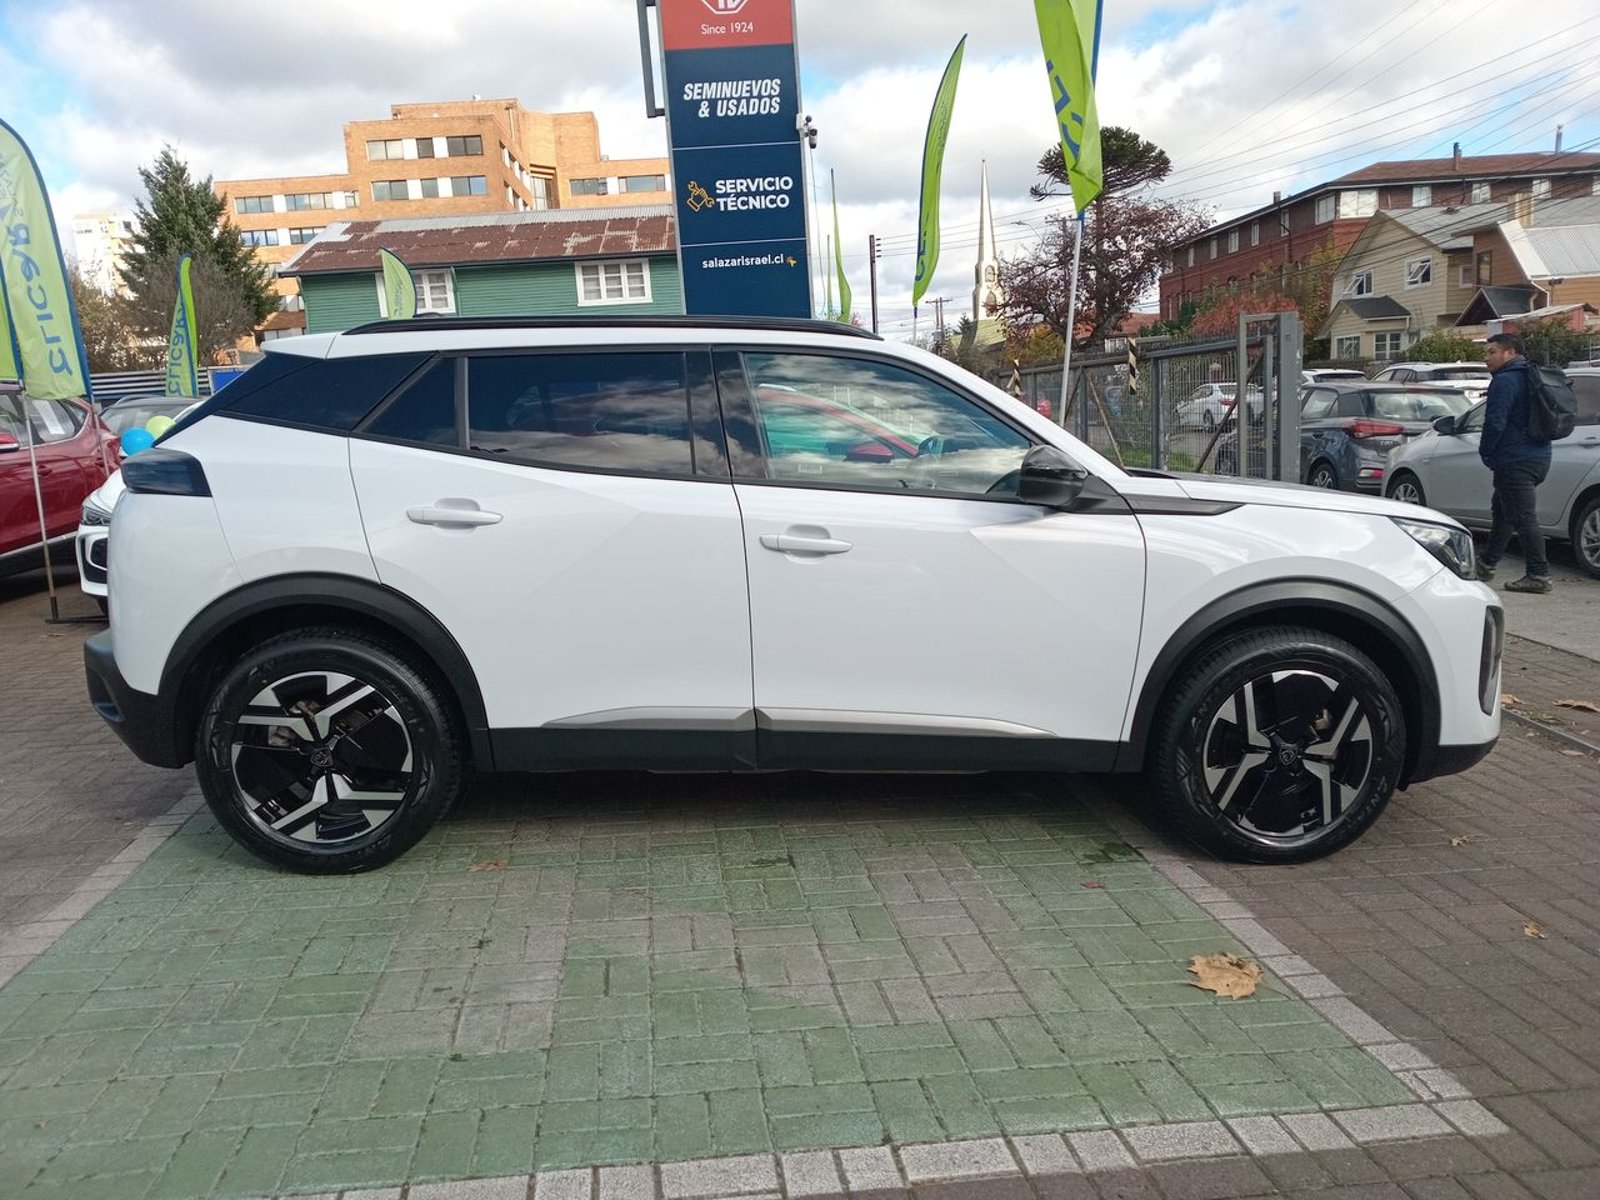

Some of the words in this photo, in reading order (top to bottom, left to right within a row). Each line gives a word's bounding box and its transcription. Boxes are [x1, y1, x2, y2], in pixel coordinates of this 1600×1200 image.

[701, 23, 726, 35] Since
[730, 21, 754, 33] 1924
[683, 78, 781, 101] SEMINUEVOS
[698, 100, 710, 118] &
[716, 96, 781, 117] USADOS
[715, 176, 793, 194] SERVICIO
[716, 194, 790, 211] TÉCNICO
[702, 254, 784, 269] salazarisrael.cl
